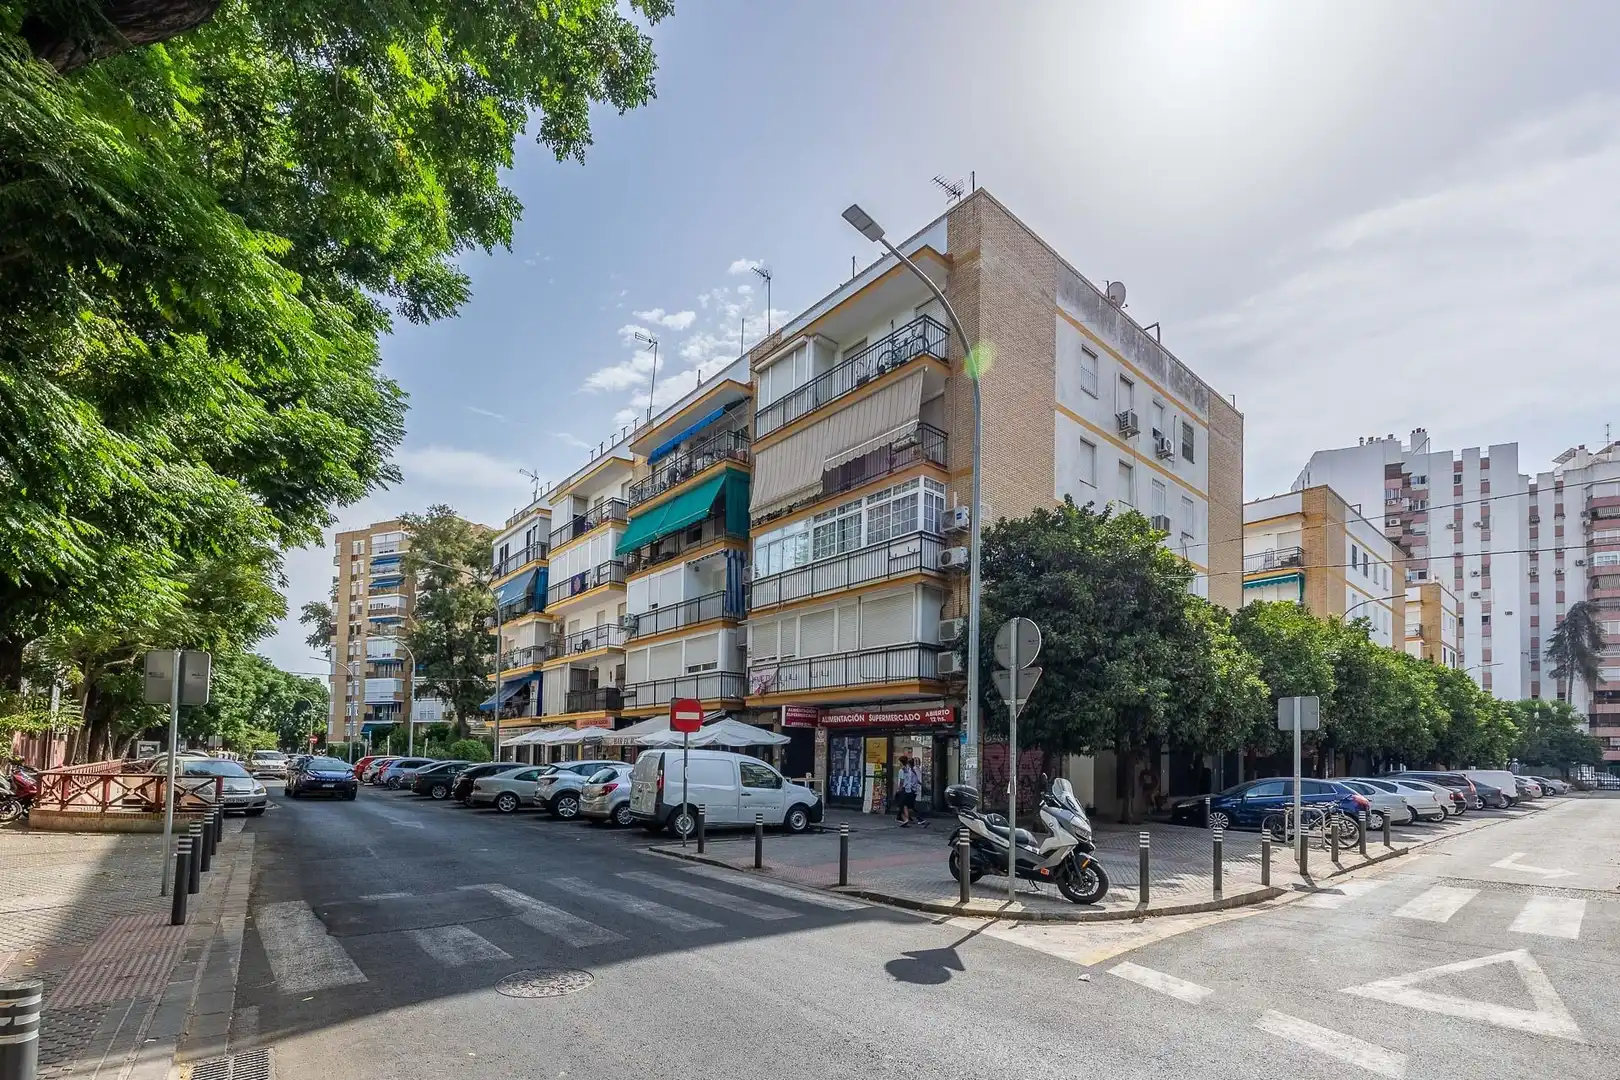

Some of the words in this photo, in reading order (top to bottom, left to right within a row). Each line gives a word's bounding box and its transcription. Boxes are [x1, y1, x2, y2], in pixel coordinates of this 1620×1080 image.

[822, 713, 865, 723] ALIMENTACIÓN
[868, 712, 921, 722] SUPERMERCADO
[925, 709, 950, 717] ABIERTO
